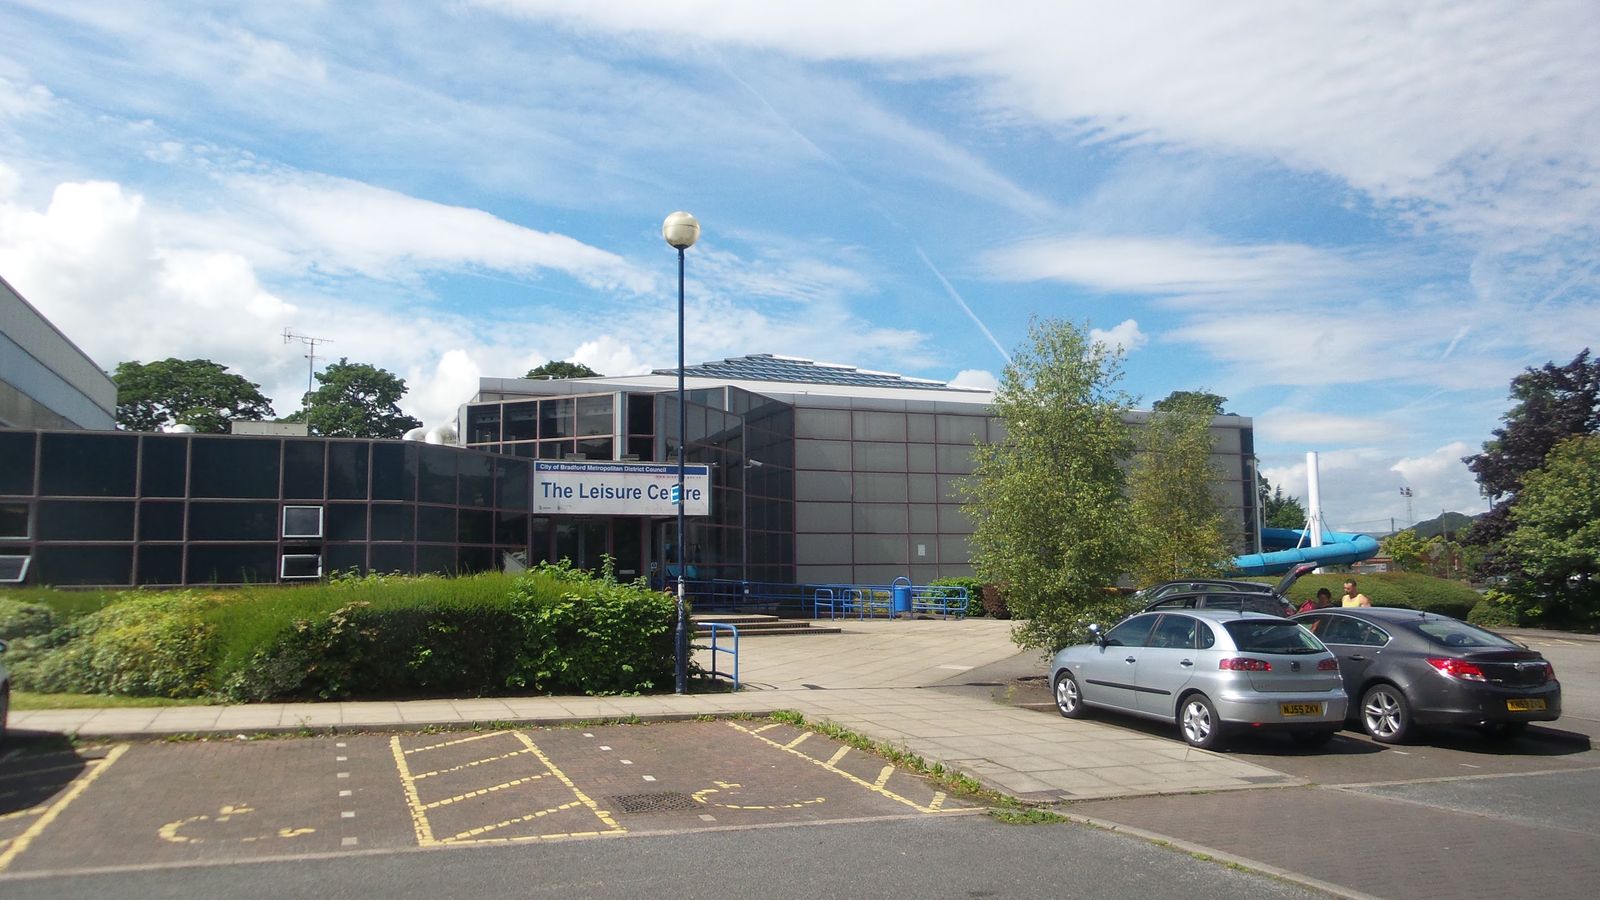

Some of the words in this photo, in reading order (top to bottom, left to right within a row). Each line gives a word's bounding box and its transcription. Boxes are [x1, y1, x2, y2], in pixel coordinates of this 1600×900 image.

[541, 481, 573, 498] The
[579, 482, 642, 499] Leisure
[647, 484, 701, 500] Cere
[1283, 704, 1304, 714] NJ55
